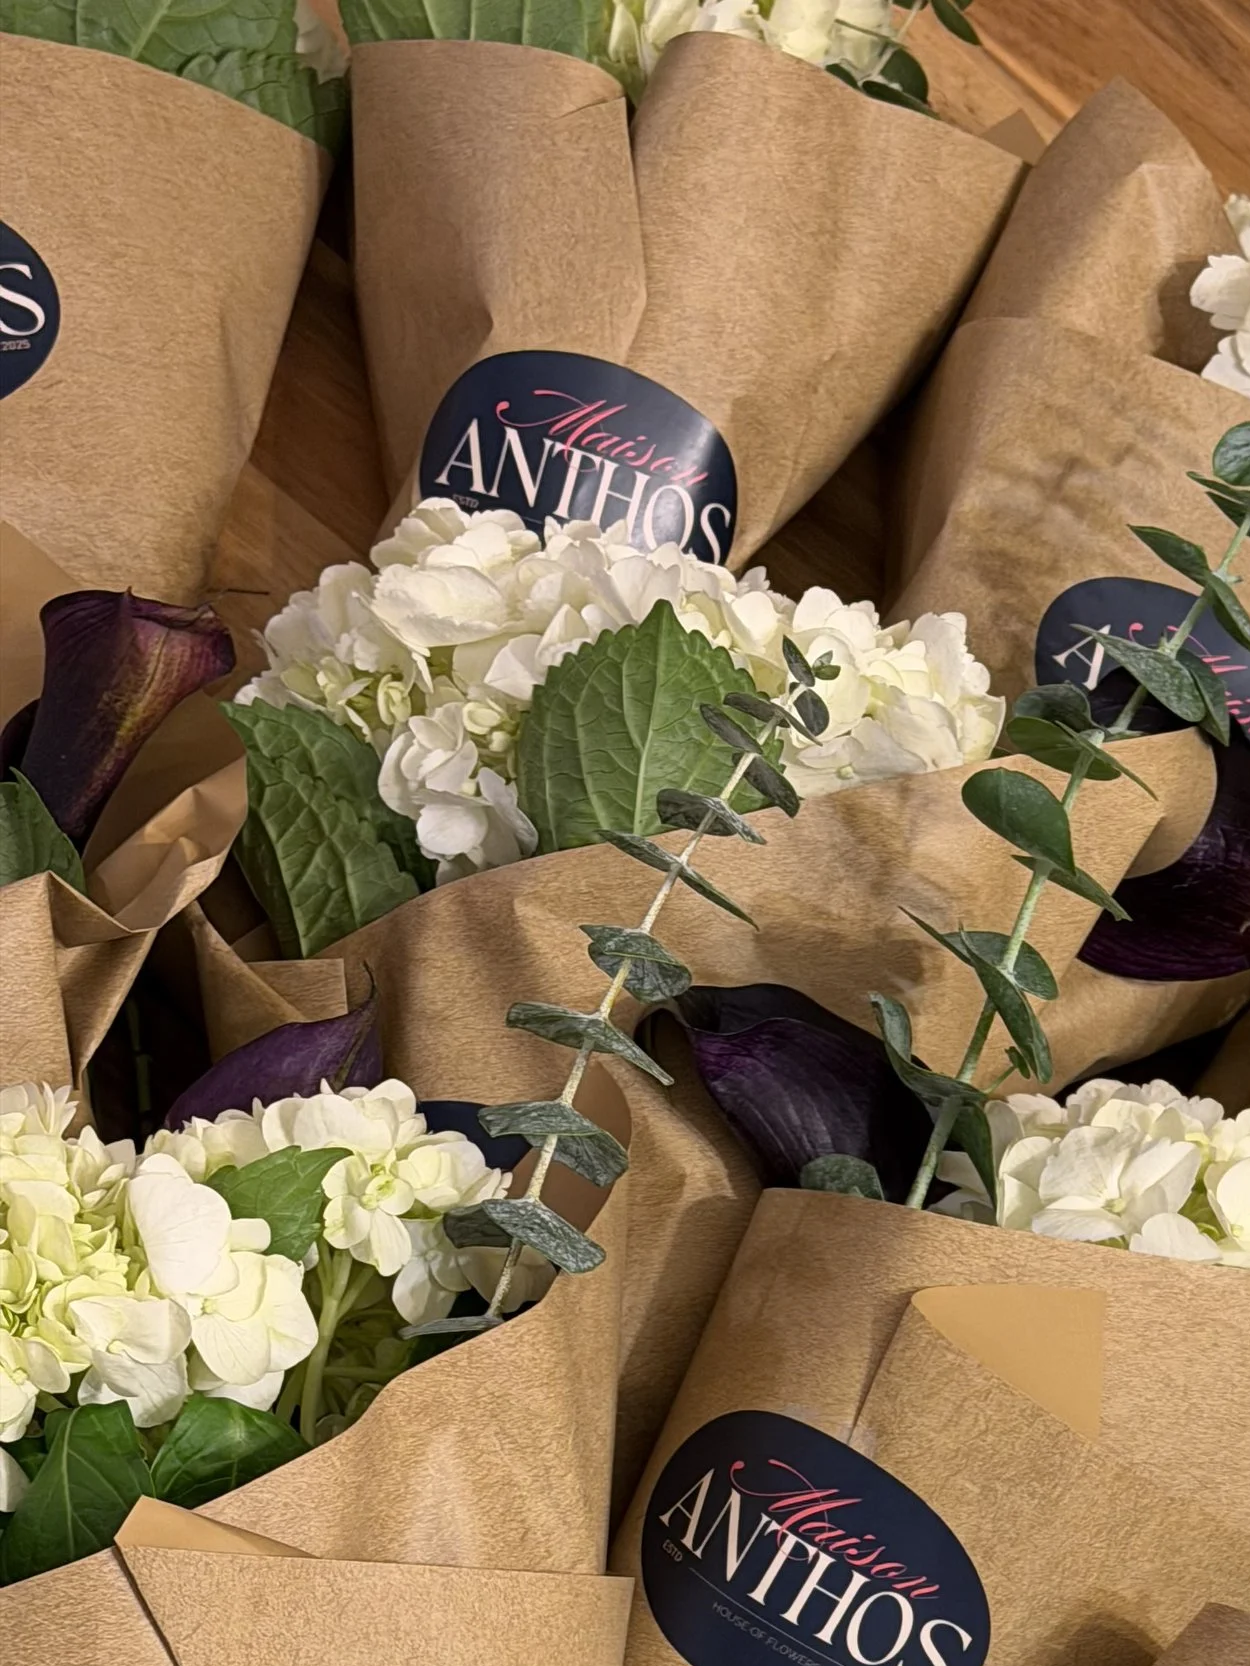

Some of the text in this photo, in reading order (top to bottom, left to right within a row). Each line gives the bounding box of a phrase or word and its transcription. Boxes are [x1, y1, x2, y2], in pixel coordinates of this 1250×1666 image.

[496, 389, 709, 487] Maison
[434, 418, 731, 565] ANTHOS
[662, 1539, 684, 1563] ESTD
[729, 1458, 941, 1600] Maison
[712, 1601, 751, 1633] HOUSE
